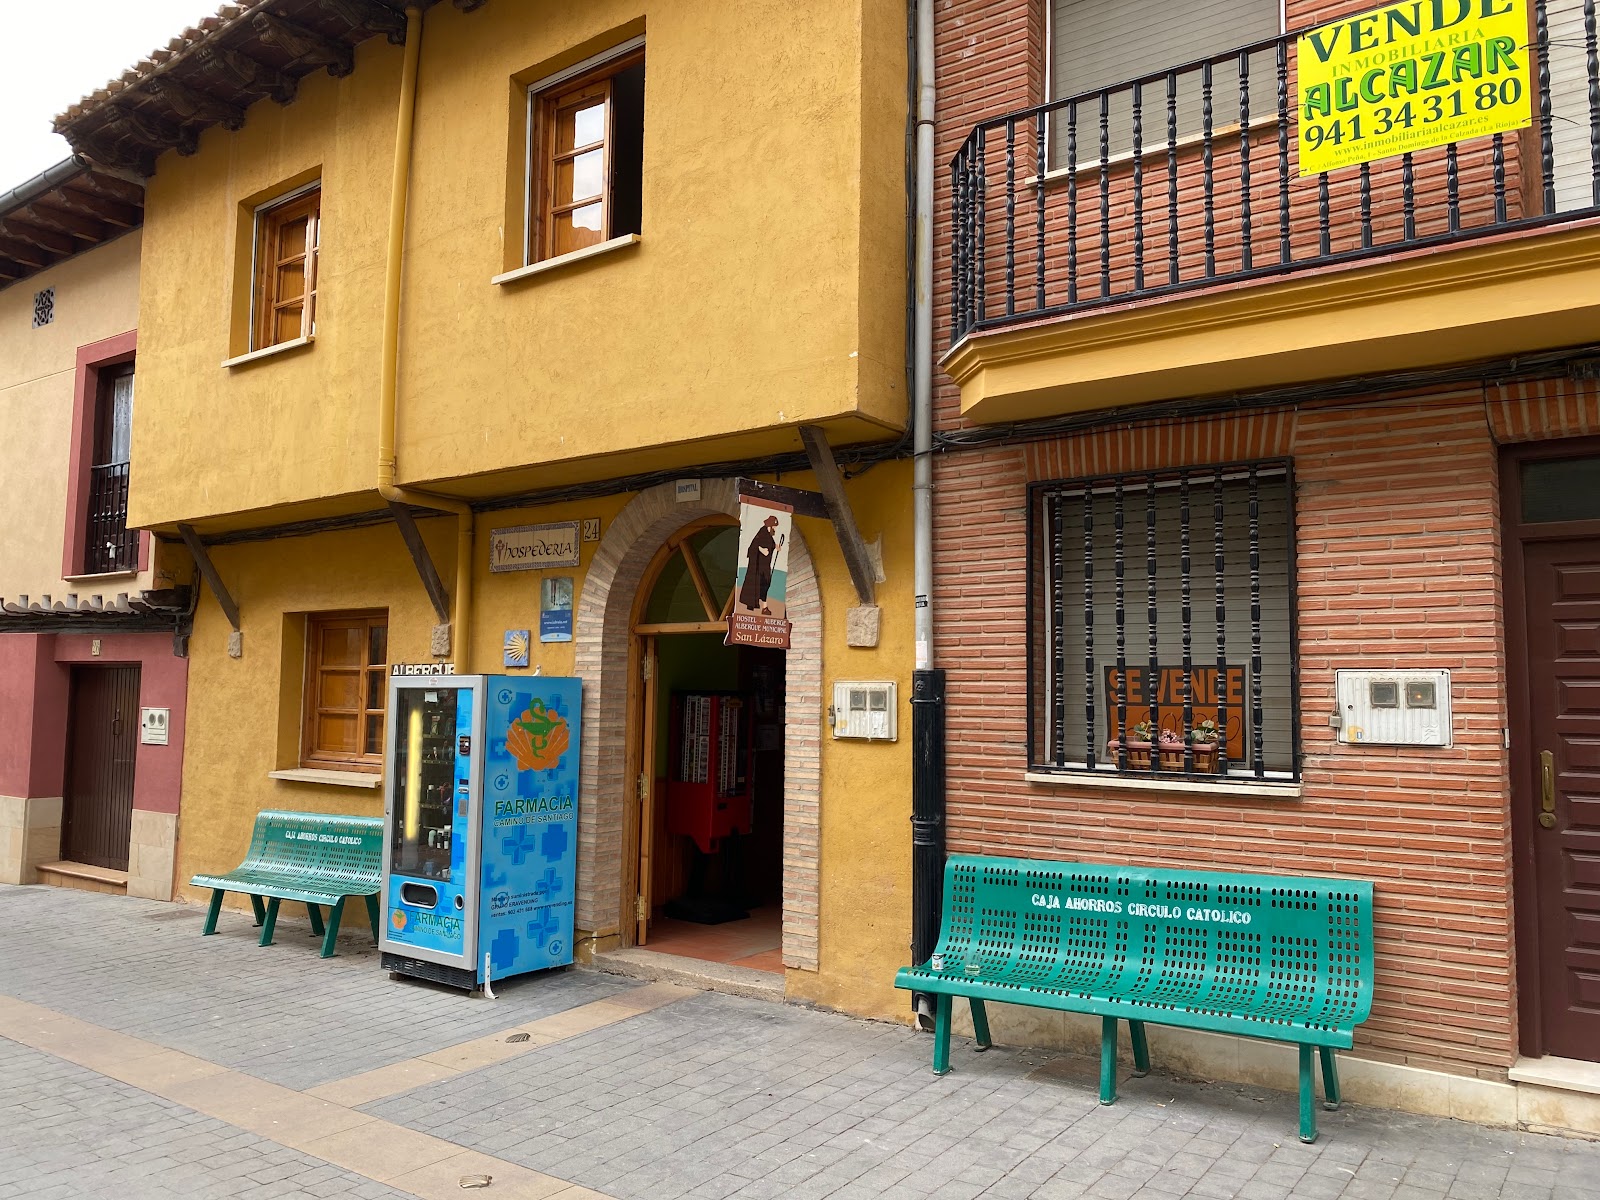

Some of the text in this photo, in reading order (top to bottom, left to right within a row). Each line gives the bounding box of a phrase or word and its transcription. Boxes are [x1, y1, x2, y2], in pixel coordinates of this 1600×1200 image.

[1332, 28, 1485, 78] INMOBILIARIA
[1303, 36, 1521, 121] ALCAZAR
[1305, 77, 1521, 152] 941 34 31 80
[1333, 115, 1489, 157] www.inmobiliariaalcazar.es
[1449, 126, 1479, 138] Calzada
[584, 521, 599, 540] 24
[735, 622, 761, 631] ALBERGUE
[736, 615, 757, 623] HOSTEL
[735, 631, 783, 645] San Lázaro
[1109, 669, 1142, 704] SE
[495, 795, 573, 816] FARMACIA
[524, 815, 536, 825] DE
[537, 812, 574, 823] SANTIAGO
[1031, 893, 1252, 924] CAJA AHORROS CIRCULO CATOLICO
[409, 911, 460, 931] FARMACIA
